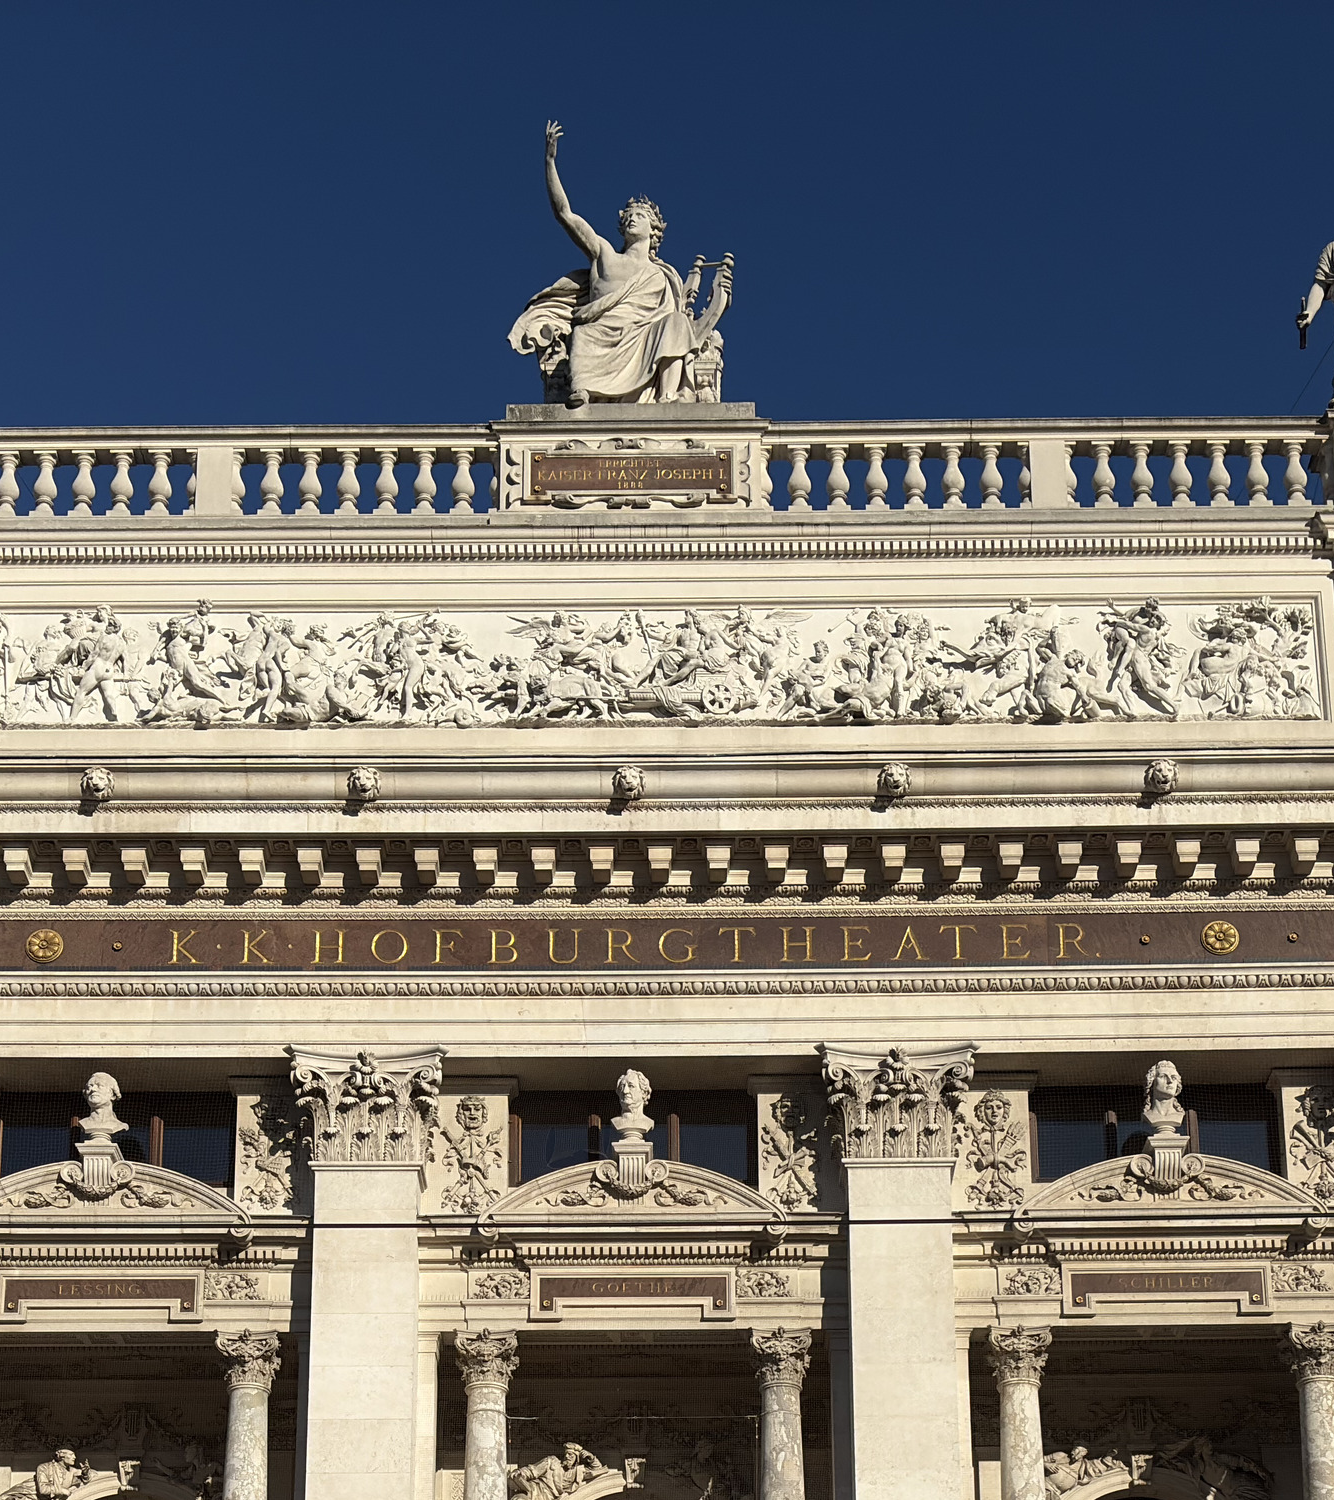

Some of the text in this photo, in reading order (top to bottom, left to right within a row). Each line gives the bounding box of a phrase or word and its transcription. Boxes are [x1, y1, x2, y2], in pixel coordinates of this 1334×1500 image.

[537, 470, 592, 481] KAISER
[597, 469, 648, 480] FRANZ
[654, 468, 713, 480] JOSEPH
[617, 481, 644, 490] 1888
